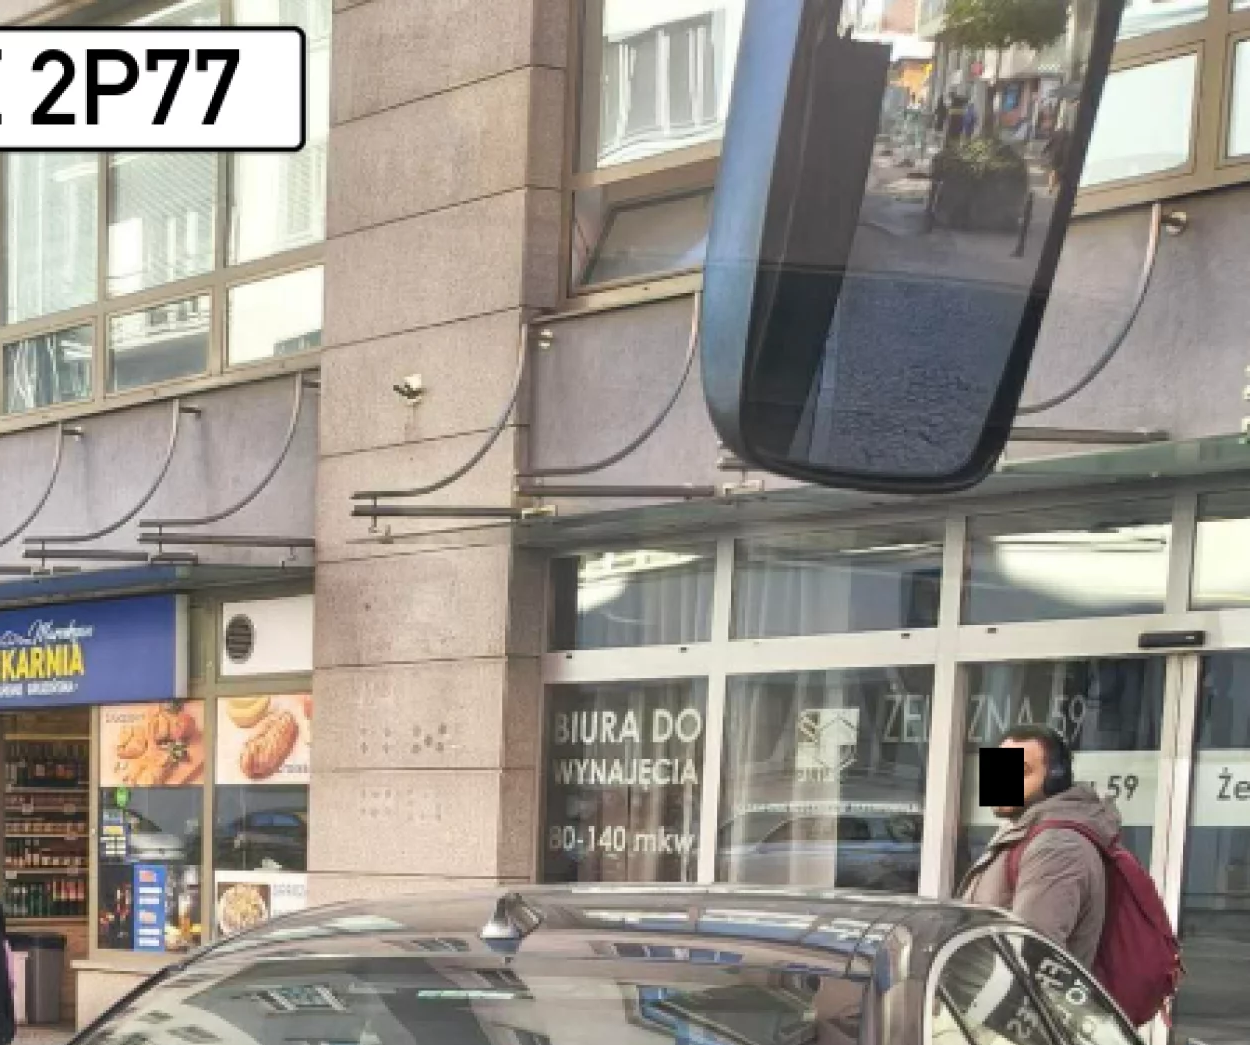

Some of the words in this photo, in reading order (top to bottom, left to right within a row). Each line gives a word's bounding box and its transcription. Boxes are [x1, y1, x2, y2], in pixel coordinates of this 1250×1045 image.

[554, 710, 640, 744] BIURA
[651, 708, 702, 743] DO
[554, 758, 699, 791] WYNAJĘCIA
[1107, 774, 1139, 800] 59
[551, 824, 626, 852] 80-140
